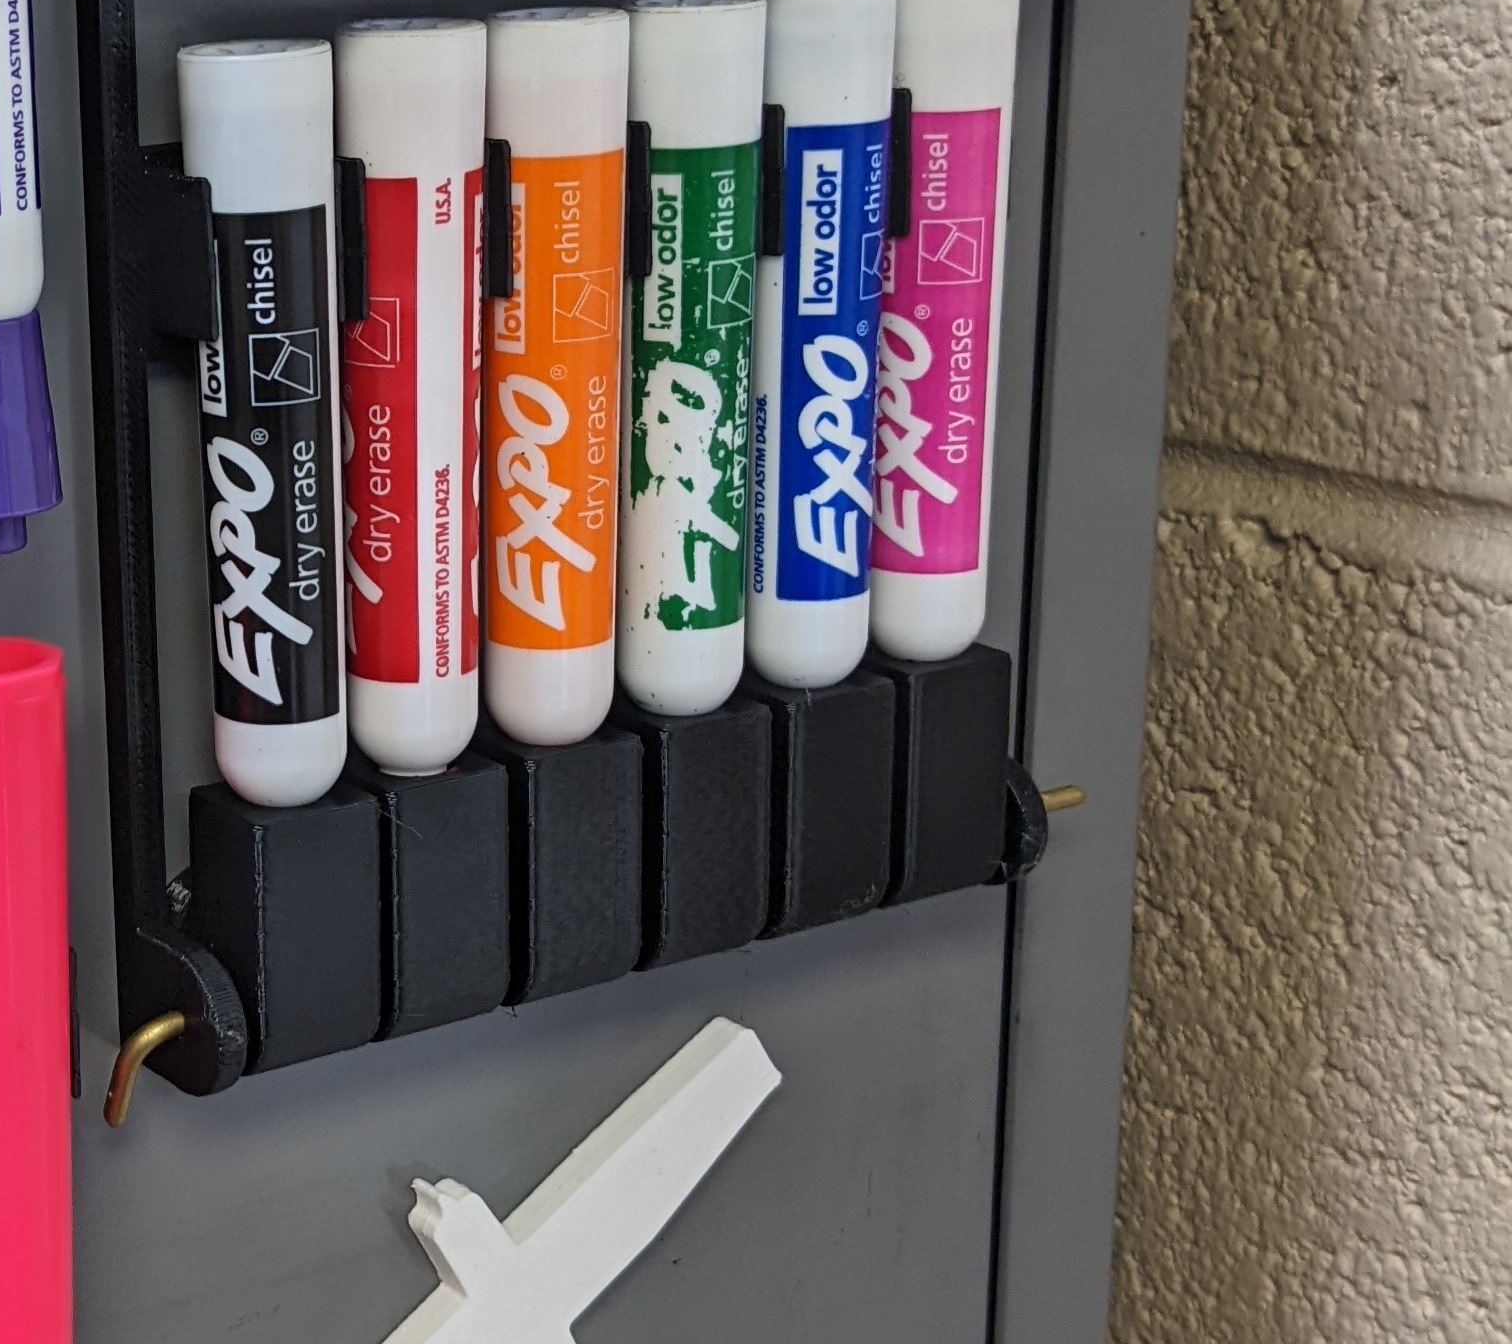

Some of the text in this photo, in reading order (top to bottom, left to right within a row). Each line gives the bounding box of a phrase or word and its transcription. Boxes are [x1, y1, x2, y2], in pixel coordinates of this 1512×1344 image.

[9, 28, 22, 81] ASTM
[12, 85, 25, 110] TO
[13, 111, 29, 211] CONFORMS
[434, 177, 452, 226] U.S.A.
[709, 169, 736, 252] chisel
[863, 143, 883, 224] chisel
[921, 133, 949, 212] chisel
[553, 180, 581, 264] chisel
[648, 187, 678, 330] low odor
[802, 163, 838, 304] low odor
[244, 238, 277, 325] chisel
[496, 288, 522, 343] low
[203, 342, 223, 404] low
[938, 317, 976, 464] dry erase
[368, 404, 391, 497] erase
[578, 375, 610, 530] dry erase
[726, 356, 749, 509] dry erase
[793, 334, 873, 578] EXPO
[873, 311, 960, 557] EXPO
[288, 440, 326, 601] dry erase
[362, 504, 401, 563] dry
[496, 374, 597, 632] EXPO
[753, 393, 768, 594] CONFORMS TO ASTM D4236.
[206, 436, 313, 706] EXPO
[435, 463, 451, 678] CONFORMS TO ASTM D4236.
